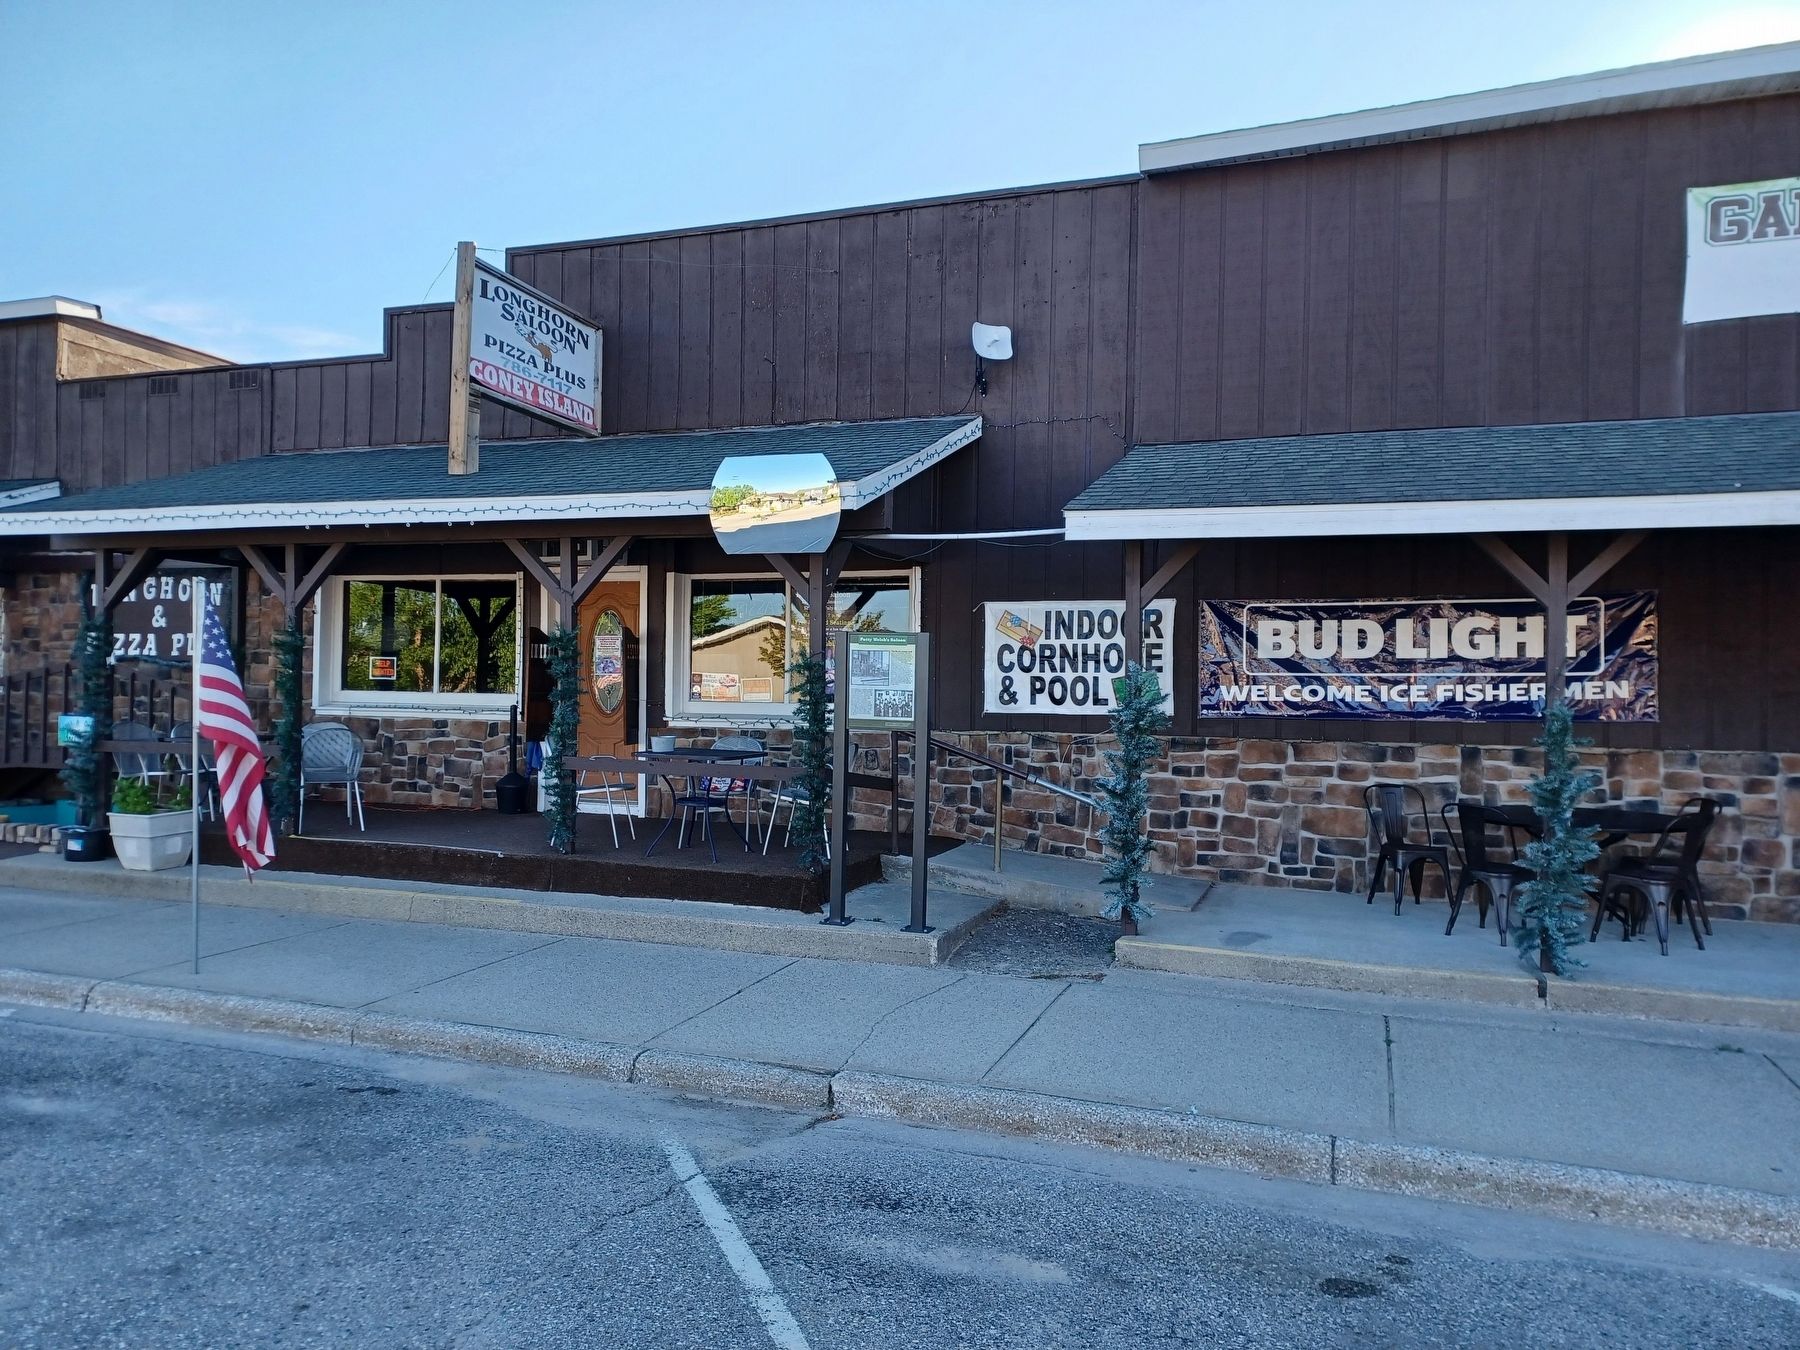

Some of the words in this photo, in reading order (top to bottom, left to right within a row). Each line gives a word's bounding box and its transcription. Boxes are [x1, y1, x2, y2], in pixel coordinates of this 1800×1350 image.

[479, 278, 589, 350] LONGHORN
[501, 303, 576, 355] SALOON
[484, 333, 539, 369] PIZZA
[543, 361, 586, 390] PLUS
[470, 360, 535, 404] CONEY
[538, 387, 594, 425] ISLAND
[151, 604, 168, 628] &
[1044, 609, 1164, 640] INDOR
[1257, 619, 1385, 660] BUD
[1395, 614, 1588, 660] LIGHT
[997, 643, 1164, 673] CORNHOE
[999, 676, 1018, 706] &
[1029, 675, 1109, 706] POOL
[1220, 684, 1373, 702] WELCOME
[1380, 684, 1429, 702] ICE
[1436, 680, 1630, 702] FISHERMEN
